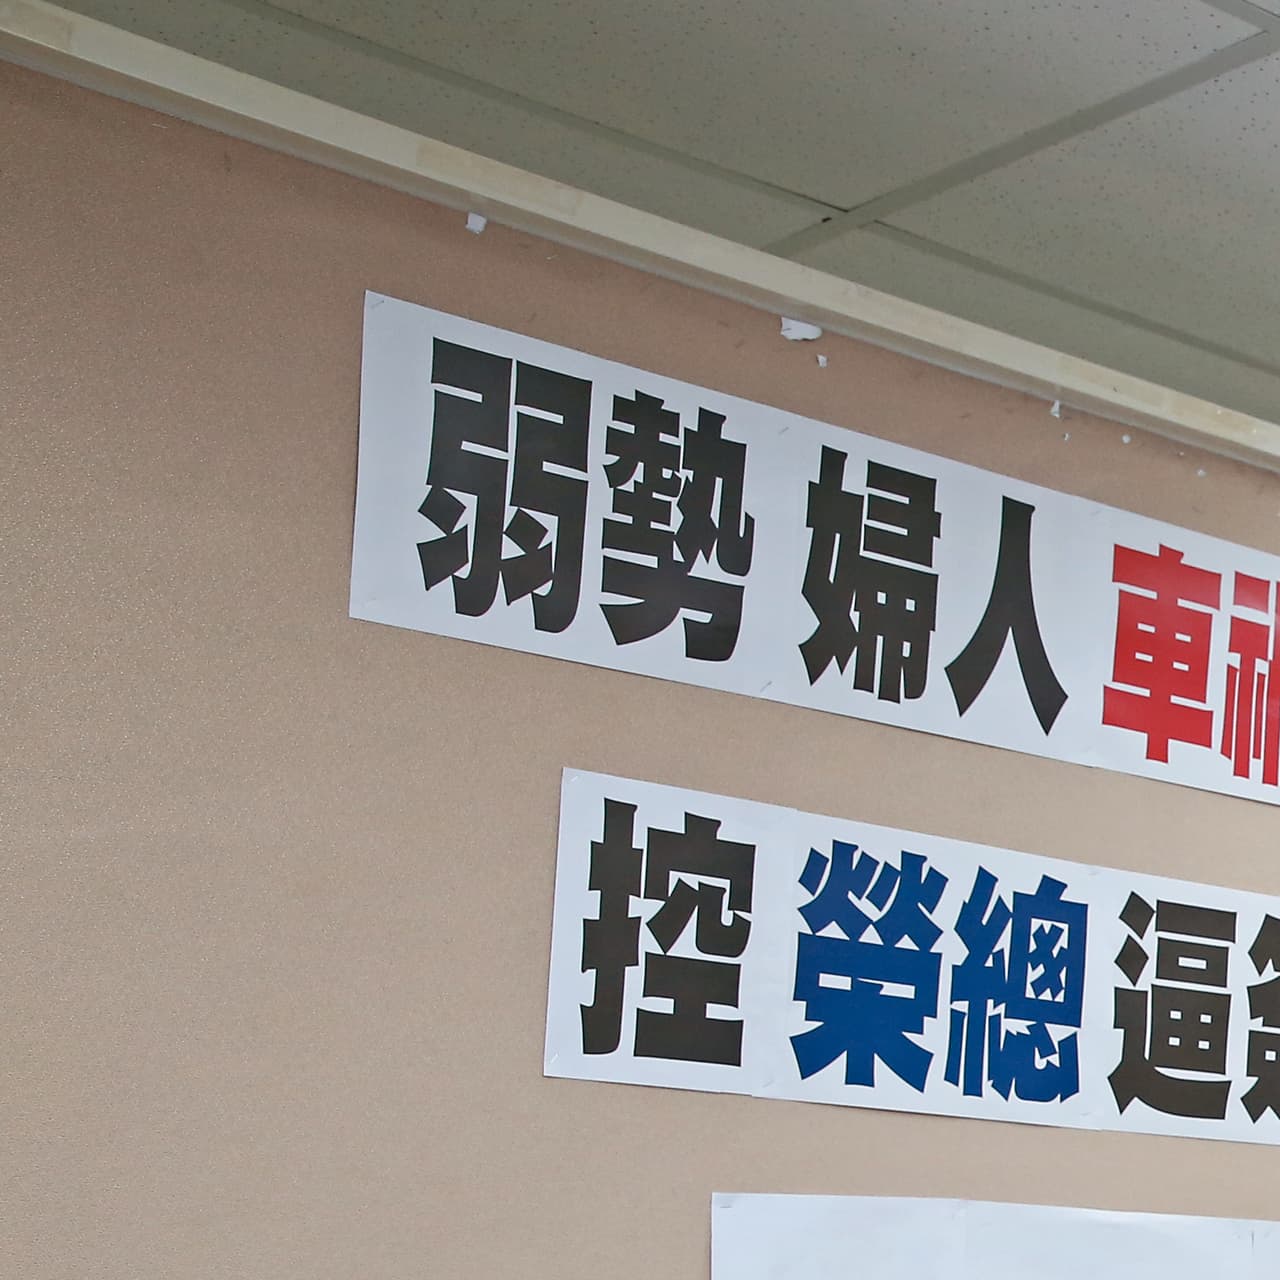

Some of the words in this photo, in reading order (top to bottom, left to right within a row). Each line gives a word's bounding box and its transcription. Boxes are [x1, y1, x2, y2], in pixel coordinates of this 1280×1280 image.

[416, 336, 755, 662] 弱勢
[798, 444, 1069, 735] 婦人
[579, 797, 757, 1067] 控
[789, 839, 1089, 1102] 榮總
